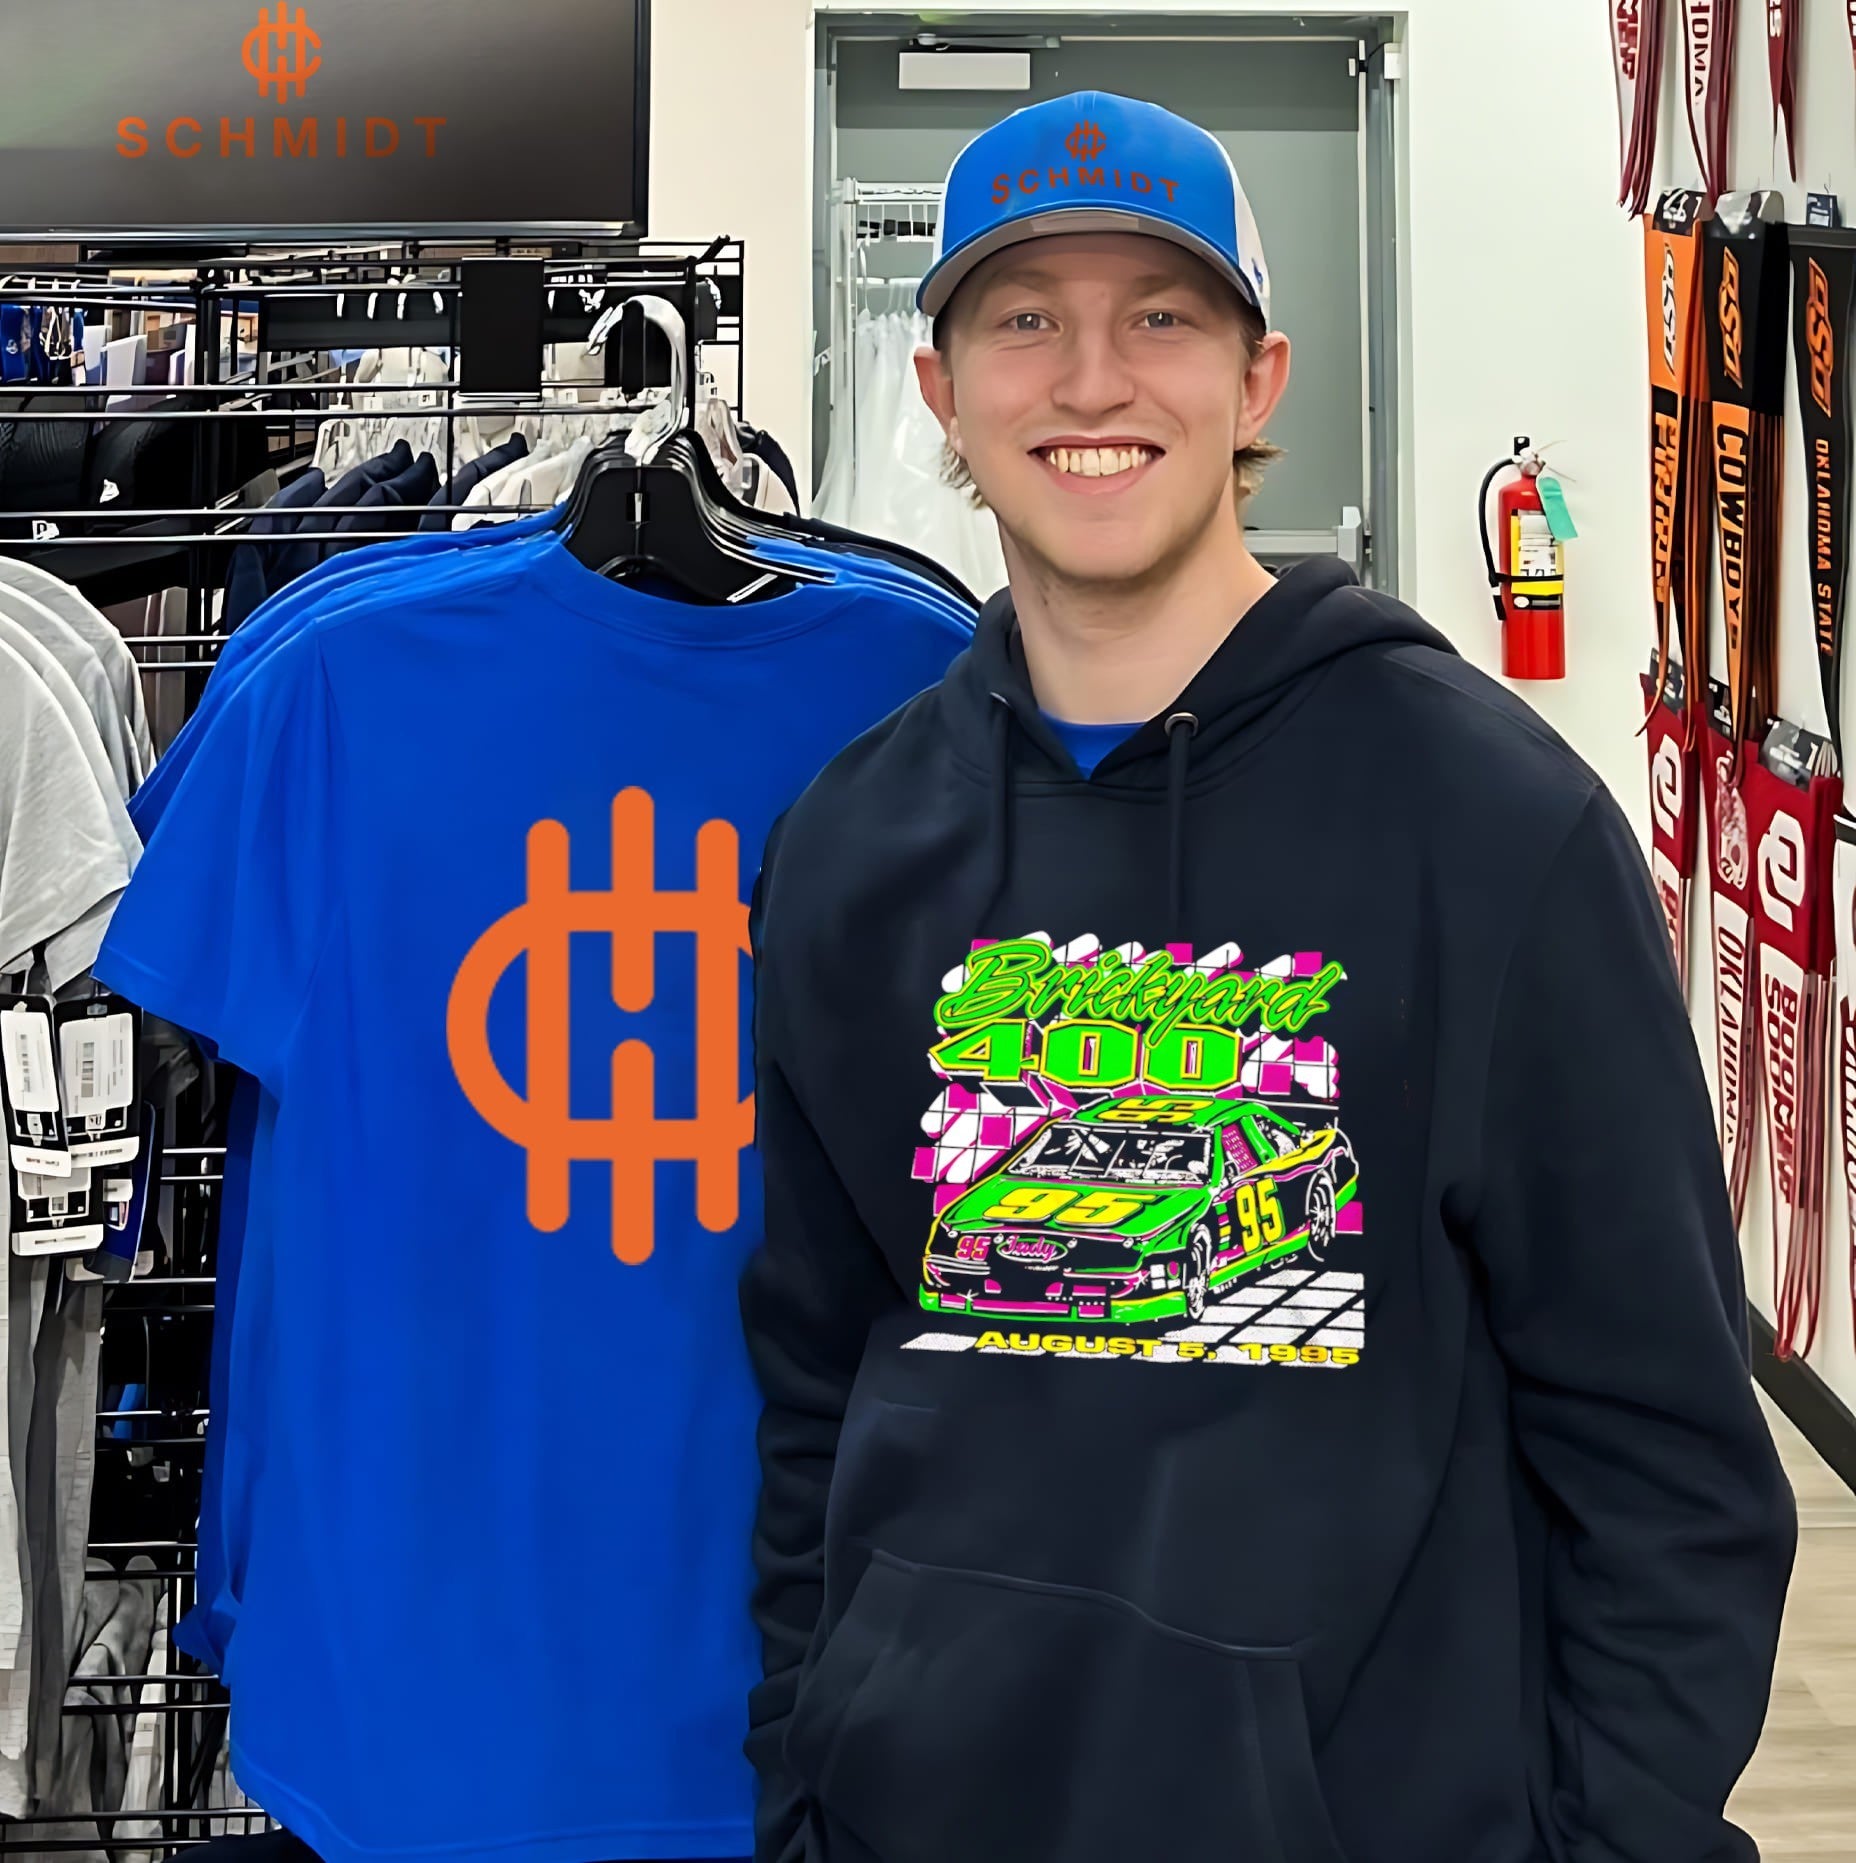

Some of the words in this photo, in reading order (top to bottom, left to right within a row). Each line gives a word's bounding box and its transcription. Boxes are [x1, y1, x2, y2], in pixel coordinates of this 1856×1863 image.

[116, 117, 447, 158] SCHMIDT
[991, 166, 1180, 205] SCHMIDT
[1716, 423, 1750, 650] COWBOY
[934, 938, 1346, 1046] Brickyard
[929, 1017, 1243, 1091] 400
[983, 1186, 1163, 1227] 95
[1236, 1177, 1284, 1256] 95
[956, 1235, 991, 1261] 95
[974, 1330, 1164, 1357] AUGUST
[1176, 1341, 1218, 1360] 5,
[1236, 1342, 1361, 1367] 1995
